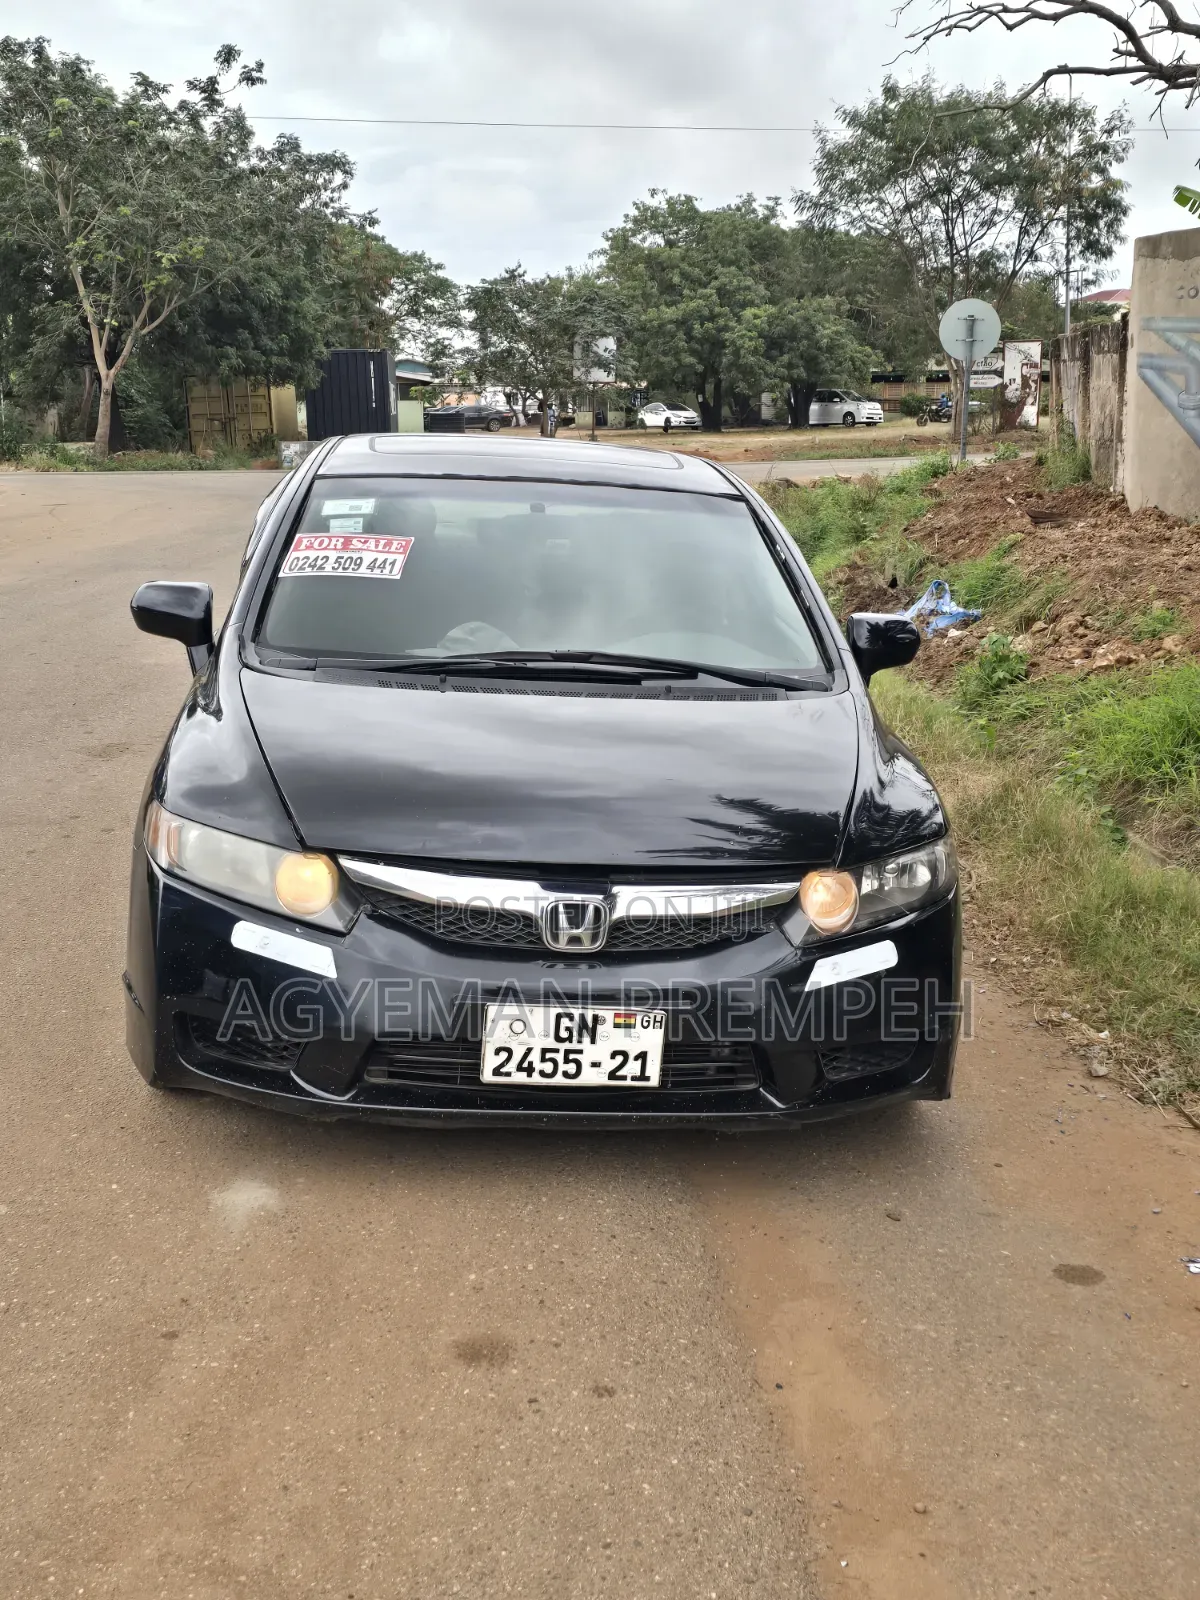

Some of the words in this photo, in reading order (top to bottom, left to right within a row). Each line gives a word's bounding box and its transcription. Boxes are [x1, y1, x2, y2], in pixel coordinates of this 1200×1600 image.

[298, 536, 344, 550] FOR
[349, 537, 406, 553] SALE
[288, 555, 330, 572] 0242
[331, 555, 364, 572] 509
[365, 557, 398, 574] 441
[554, 1011, 599, 1045] GN
[640, 1014, 664, 1030] GH
[491, 1045, 651, 1082] 2455-21
